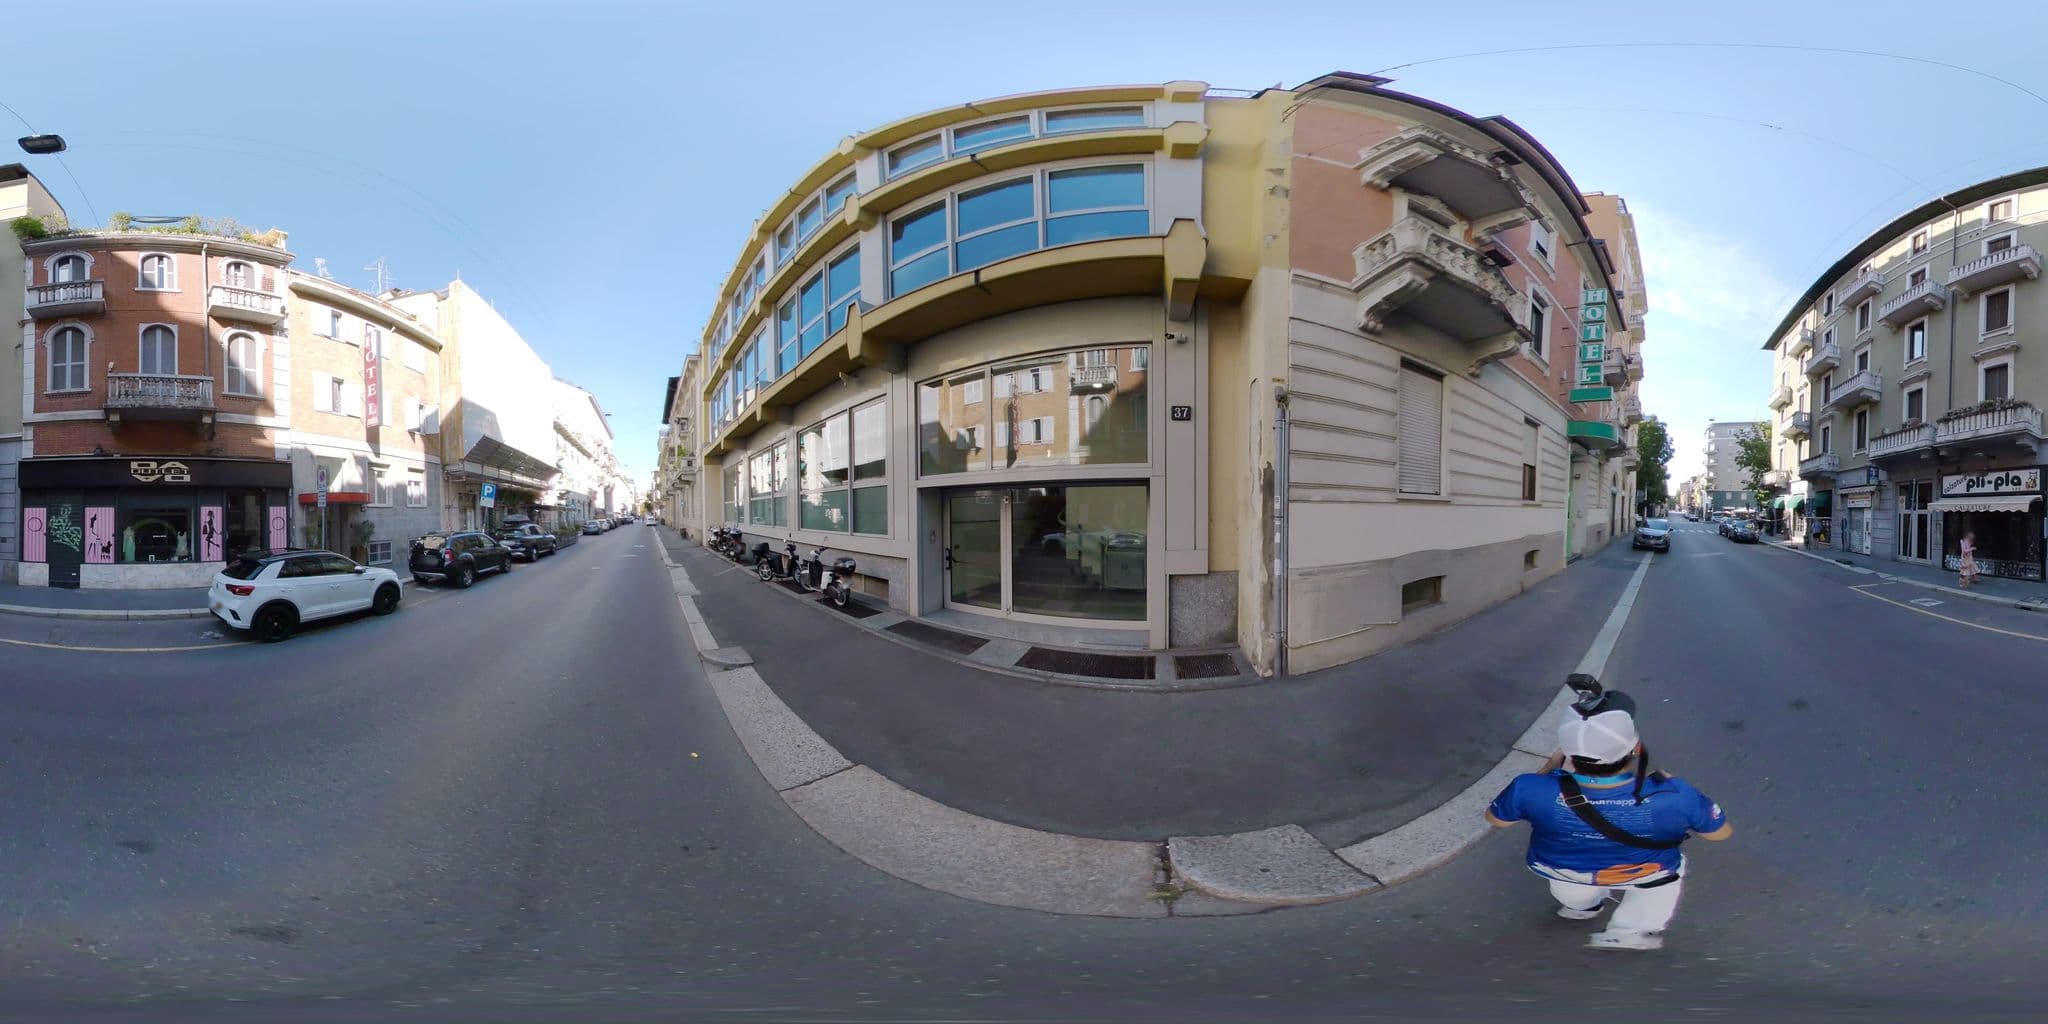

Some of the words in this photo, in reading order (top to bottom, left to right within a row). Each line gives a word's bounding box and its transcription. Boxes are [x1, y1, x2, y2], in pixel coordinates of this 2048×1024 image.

[1582, 290, 1604, 382] HOTEL
[1174, 407, 1188, 418] 37
[1966, 472, 2022, 492] pli-pla
[484, 485, 493, 497] P
